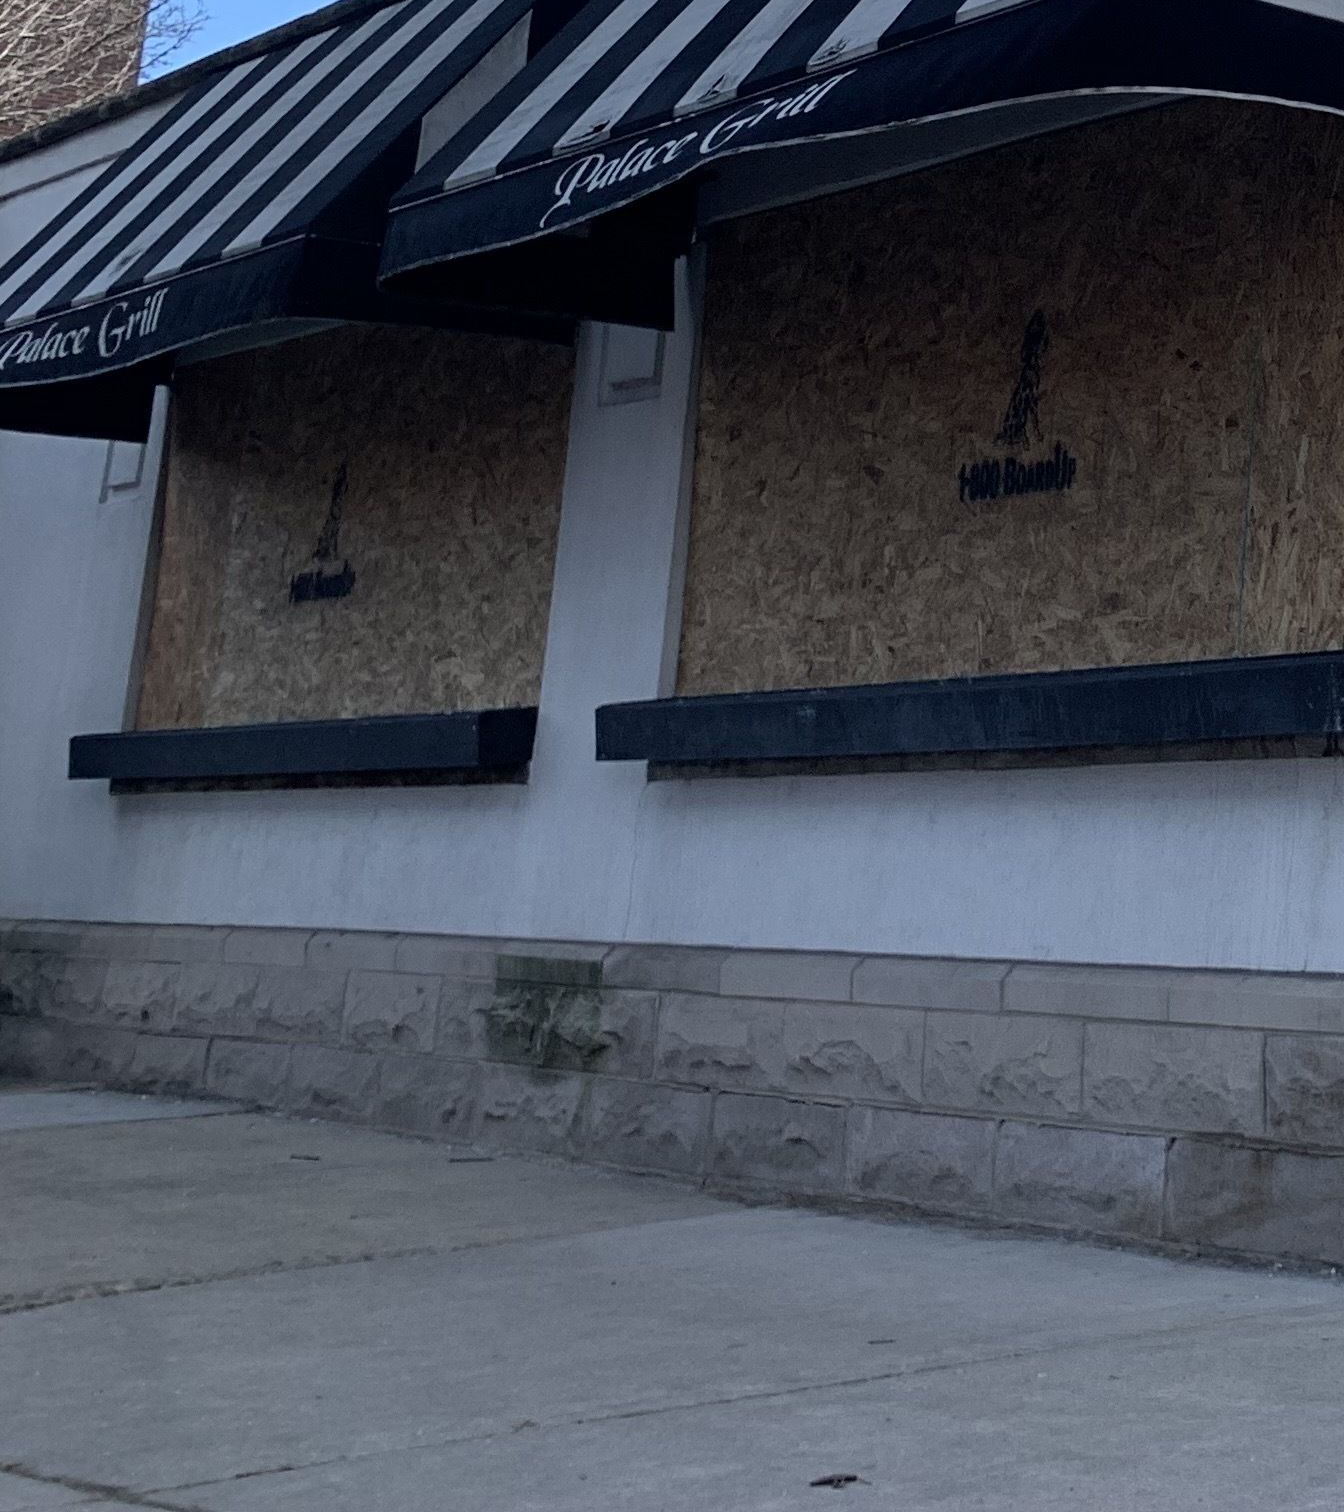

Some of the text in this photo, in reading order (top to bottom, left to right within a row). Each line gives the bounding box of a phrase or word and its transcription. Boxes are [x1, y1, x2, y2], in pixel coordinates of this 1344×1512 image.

[540, 68, 858, 228] Palace Grill
[0, 287, 170, 371] Palace Grill
